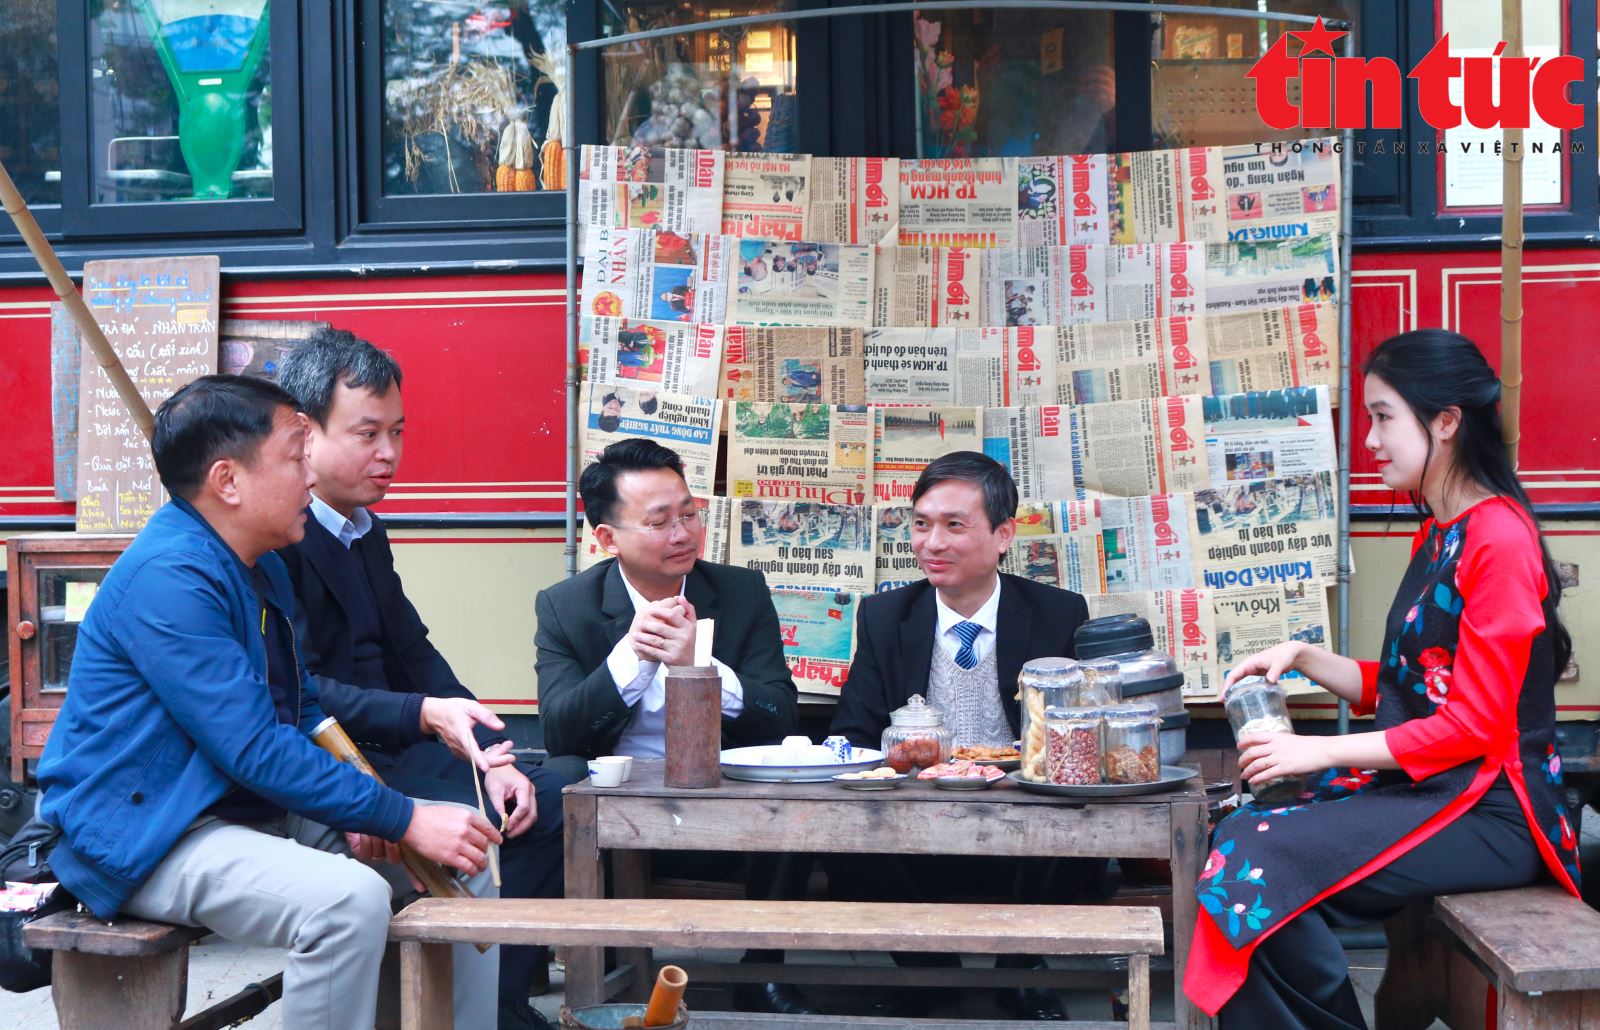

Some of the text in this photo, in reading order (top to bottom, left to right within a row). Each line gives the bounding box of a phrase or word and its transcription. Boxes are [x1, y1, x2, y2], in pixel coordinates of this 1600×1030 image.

[1248, 170, 1304, 185] Ngân hàng
[596, 249, 608, 283] ĐẠI
[607, 236, 627, 285] NHÂN
[120, 317, 139, 335] ĐÁ
[152, 320, 188, 334] NHÂN
[880, 346, 892, 357] du
[894, 346, 906, 357] đồ
[908, 346, 926, 358] bản
[928, 347, 947, 357] trên
[872, 360, 948, 371] TP.HCM sẽ thành
[662, 401, 710, 417] thành công
[658, 411, 709, 428] khởi nghiệp
[1044, 406, 1060, 436] Dân
[649, 424, 670, 435] THẤT
[672, 426, 692, 438] ĐỘNG
[693, 430, 708, 440] LAO
[755, 448, 769, 456] hiện
[780, 448, 798, 456] thống
[799, 448, 820, 456] truyền
[757, 464, 828, 478] Phát huy giá trị
[1238, 522, 1297, 540] sau bão lũ
[778, 546, 833, 560] sau bão lũ
[1208, 532, 1332, 560] Vực dậy doanh nghiệp
[786, 562, 819, 576] doanh
[822, 562, 840, 577] dậy
[844, 562, 863, 578] Vực
[1251, 598, 1280, 617] Khổ
